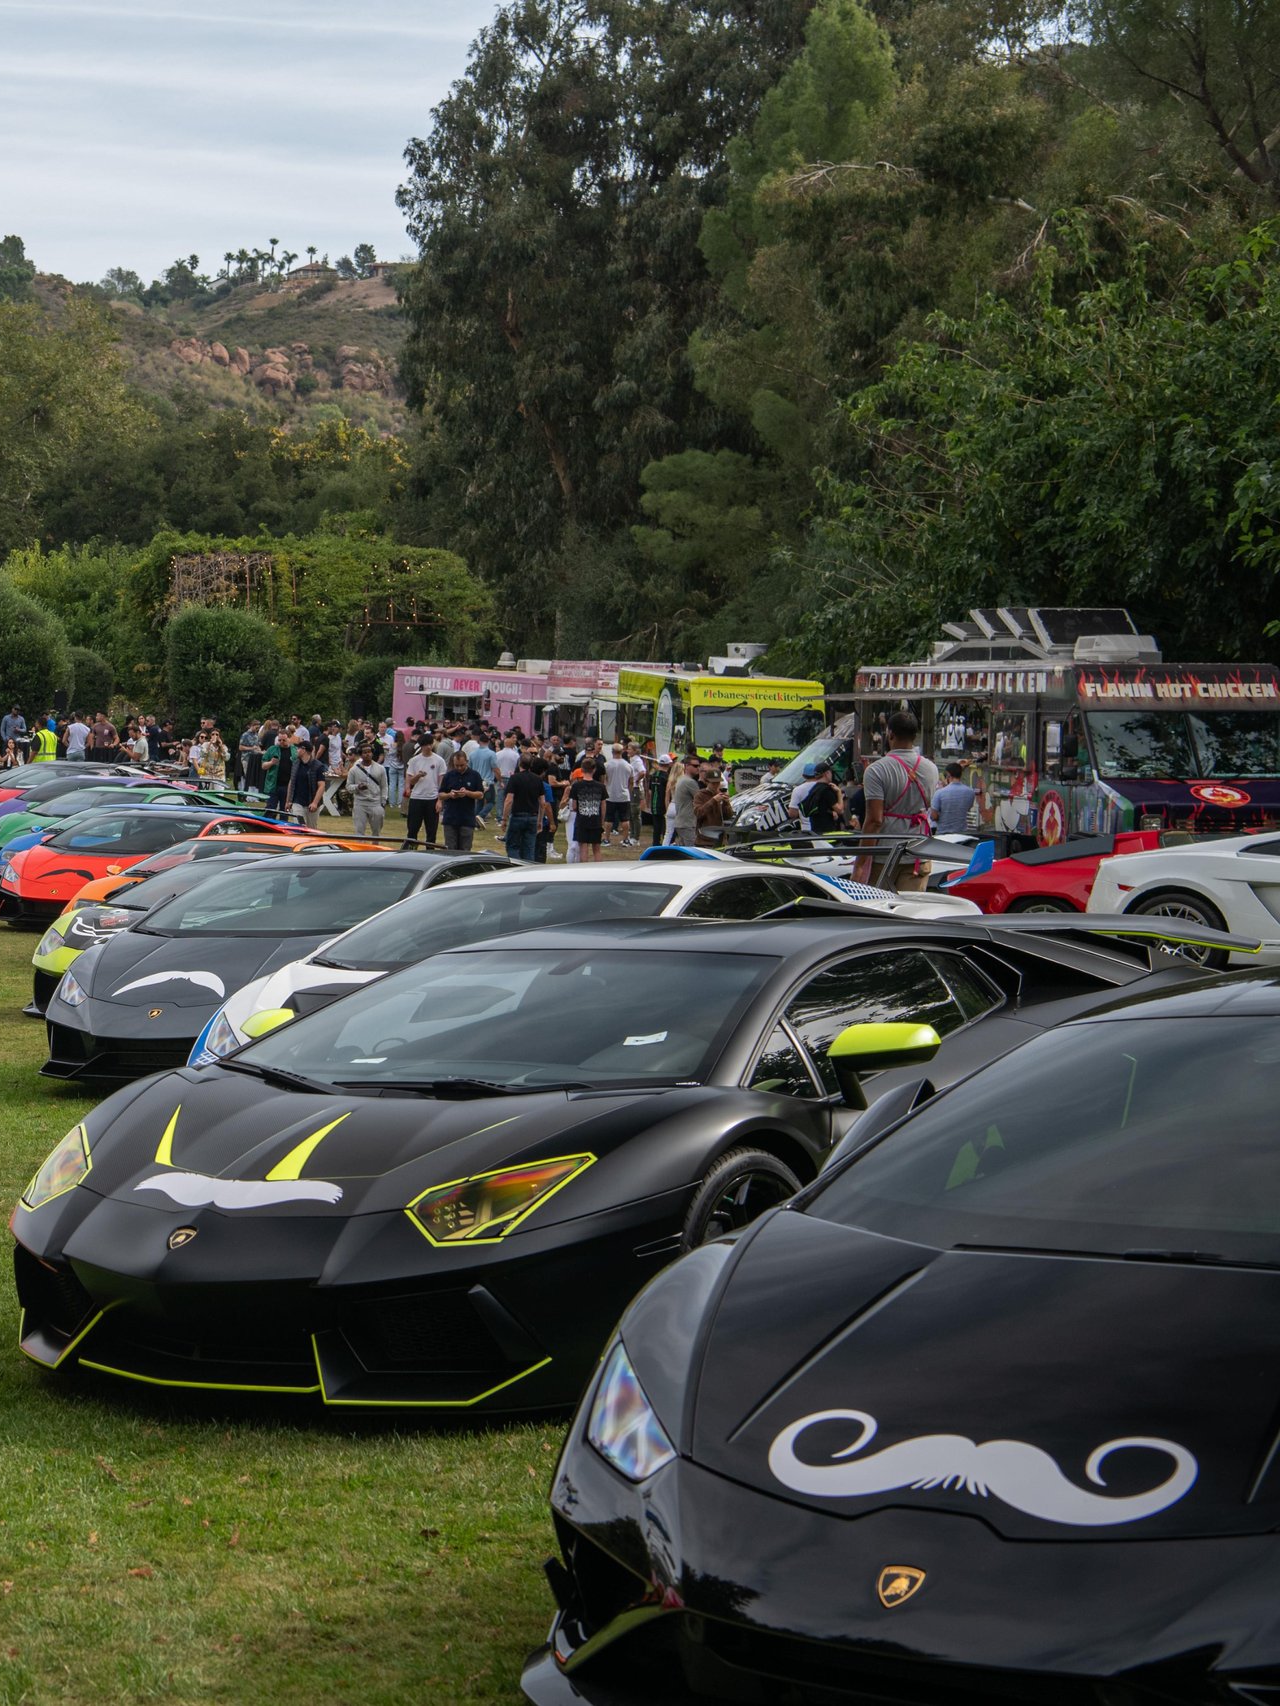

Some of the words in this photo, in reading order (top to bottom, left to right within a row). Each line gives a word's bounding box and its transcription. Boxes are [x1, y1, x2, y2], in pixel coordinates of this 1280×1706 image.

[423, 676, 441, 689] BITE
[443, 678, 451, 690] IS
[453, 678, 480, 692] NEVER
[881, 672, 931, 690] FLAMIN
[939, 672, 968, 690] HOT
[976, 672, 1047, 693] CHICKEN
[1085, 682, 1154, 698] FLAMIN
[1155, 683, 1192, 698] HOT
[1197, 683, 1277, 698] CHICKEN
[703, 689, 813, 703] #lebanesestreetkitch
